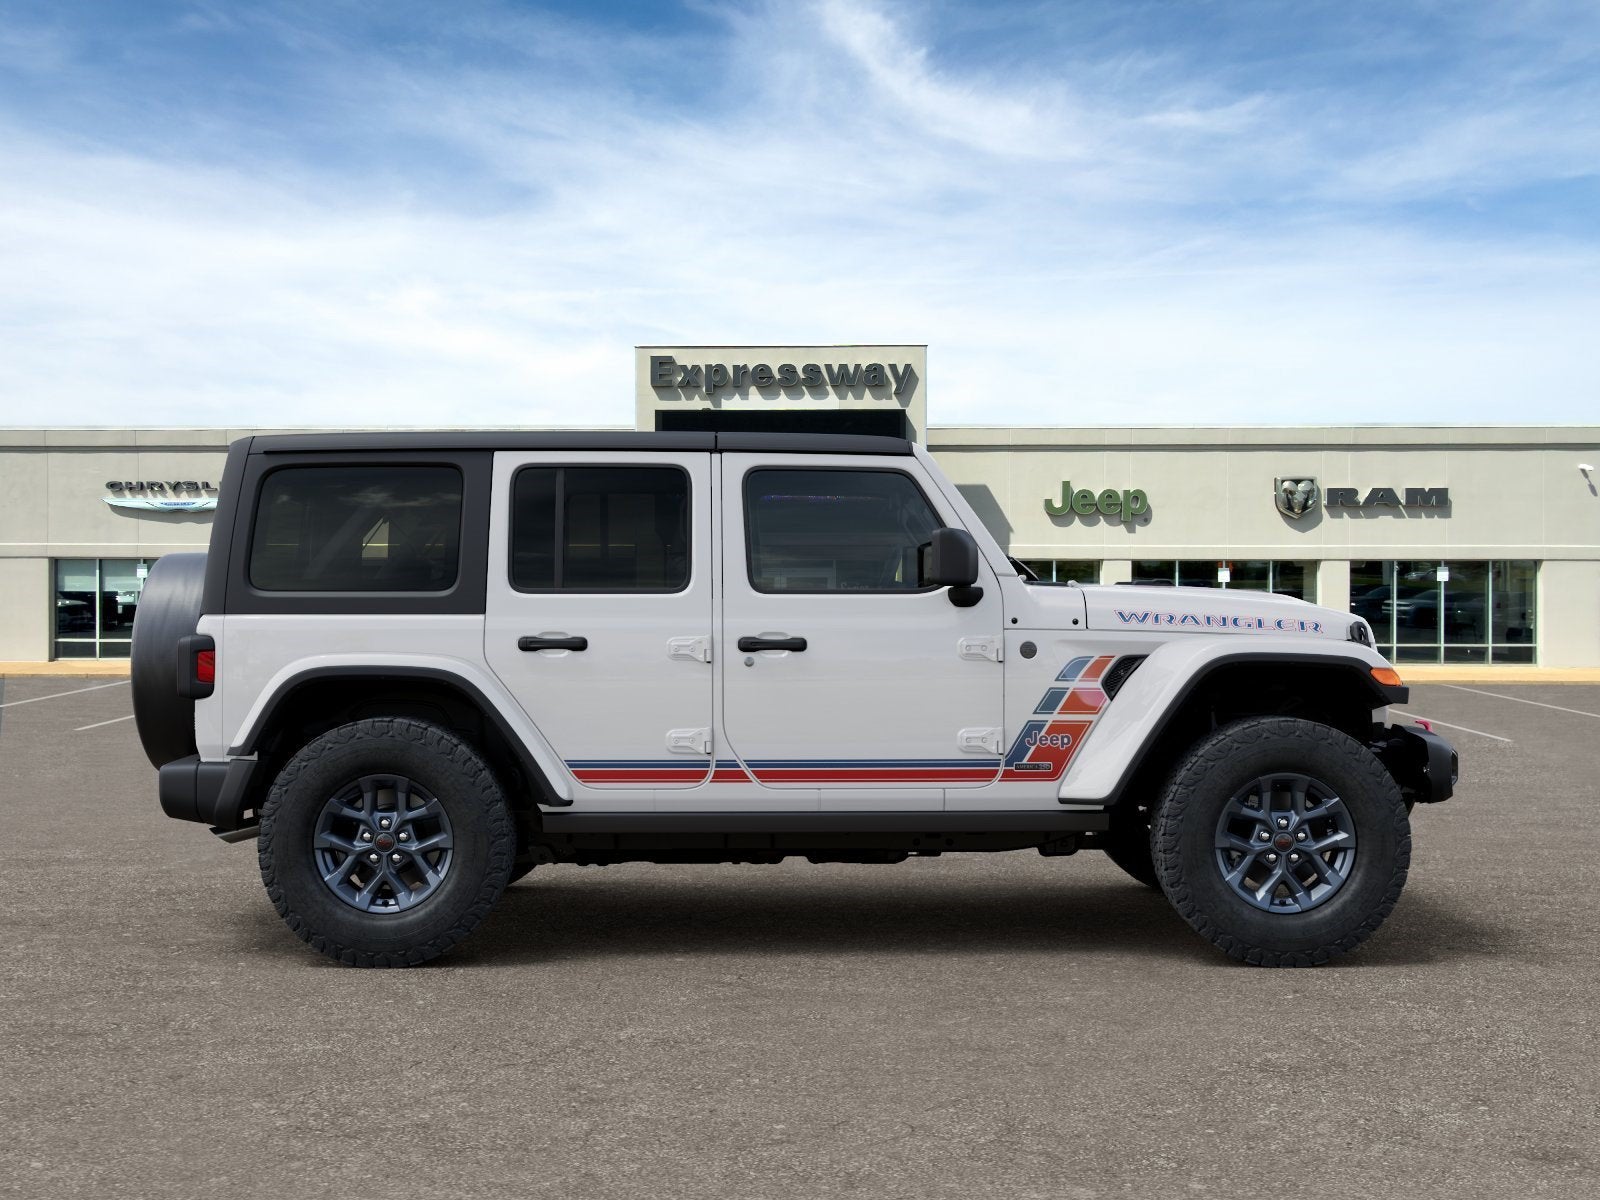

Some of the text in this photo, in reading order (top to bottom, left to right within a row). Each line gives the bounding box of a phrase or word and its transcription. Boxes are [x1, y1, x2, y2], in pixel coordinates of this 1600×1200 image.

[650, 355, 912, 394] Expressway
[105, 481, 222, 491] CHRYSL
[1044, 480, 1149, 522] Jeep
[1325, 487, 1449, 507] RAM
[1115, 610, 1323, 633] WRANGLER
[1026, 731, 1071, 749] Jeep
